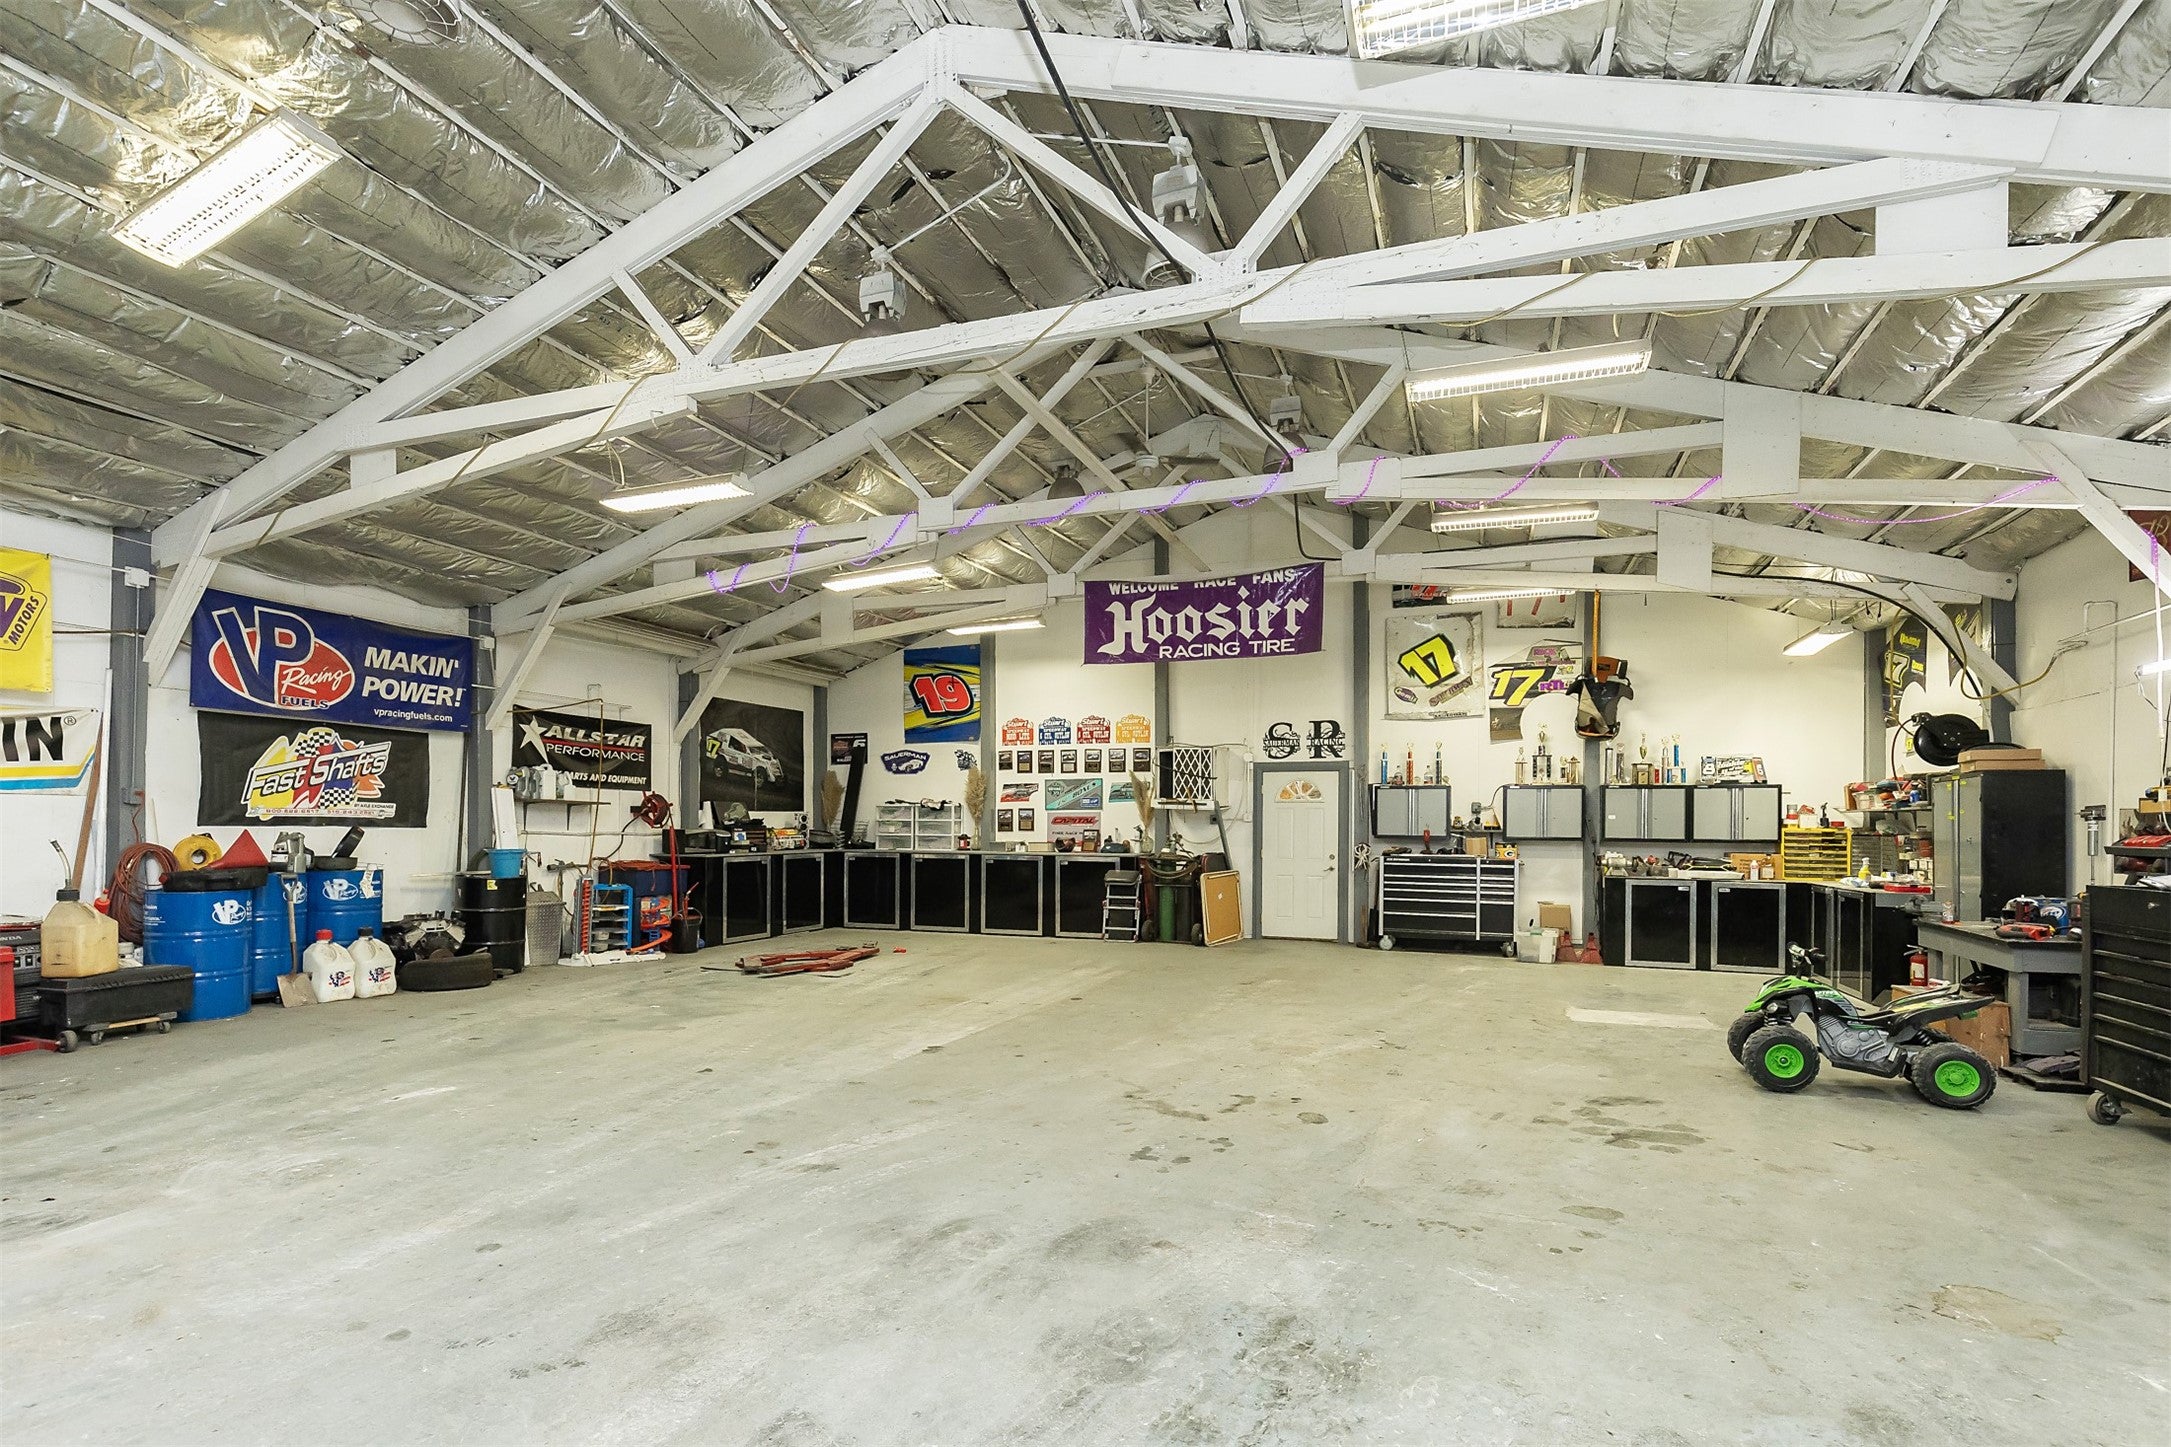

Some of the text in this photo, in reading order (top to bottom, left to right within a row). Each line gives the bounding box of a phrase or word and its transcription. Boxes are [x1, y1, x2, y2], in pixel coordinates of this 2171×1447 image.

[1253, 568, 1296, 584] FANS
[8, 595, 40, 645] MOTORS
[1097, 586, 1309, 655] Hoosier
[212, 606, 314, 708] VP
[364, 646, 459, 678] MAKIN'
[1159, 638, 1295, 659] RACING TIRE
[1399, 635, 1457, 686] 17
[281, 666, 348, 695] Racing
[362, 676, 463, 707] POWER!
[912, 674, 972, 714] 19
[1493, 668, 1546, 706] 17
[281, 696, 329, 709] FUELS
[374, 709, 453, 722] vpracingfuels.com
[545, 725, 646, 748] ALLSTAR
[546, 743, 645, 762] PERFORMANCE
[884, 752, 926, 761] SAUERMAN
[247, 743, 391, 800] Fast Shafts
[607, 774, 646, 784] EQUIPMENT
